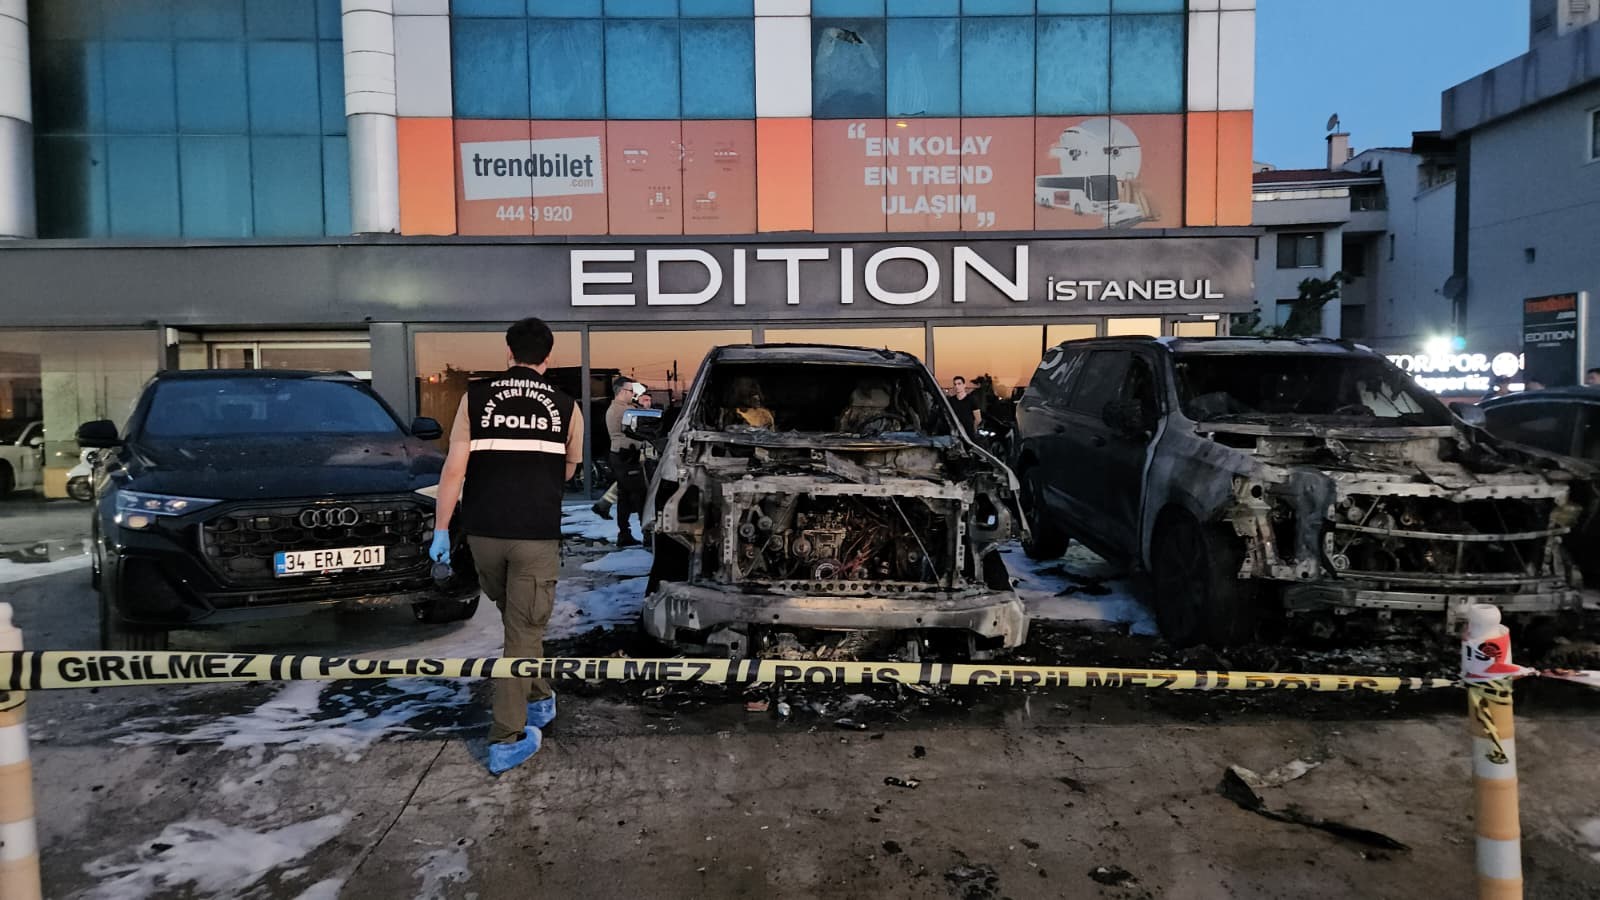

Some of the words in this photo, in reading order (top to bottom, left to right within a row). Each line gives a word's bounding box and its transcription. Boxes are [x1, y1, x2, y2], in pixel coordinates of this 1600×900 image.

[908, 136, 993, 155] KOLAY
[473, 153, 594, 178] trendbilet
[864, 167, 898, 185] EN
[907, 165, 993, 185] TREND
[569, 178, 594, 188] .com
[496, 205, 525, 221] 444
[529, 206, 539, 221] 9
[543, 206, 573, 222] 920
[881, 195, 977, 218] ULAŞIM
[570, 244, 1029, 307] EDITION
[481, 399, 497, 428] OLAY
[493, 414, 549, 430] POLİS
[286, 554, 305, 570] 34
[315, 551, 344, 568] ERA
[353, 548, 381, 565] 201
